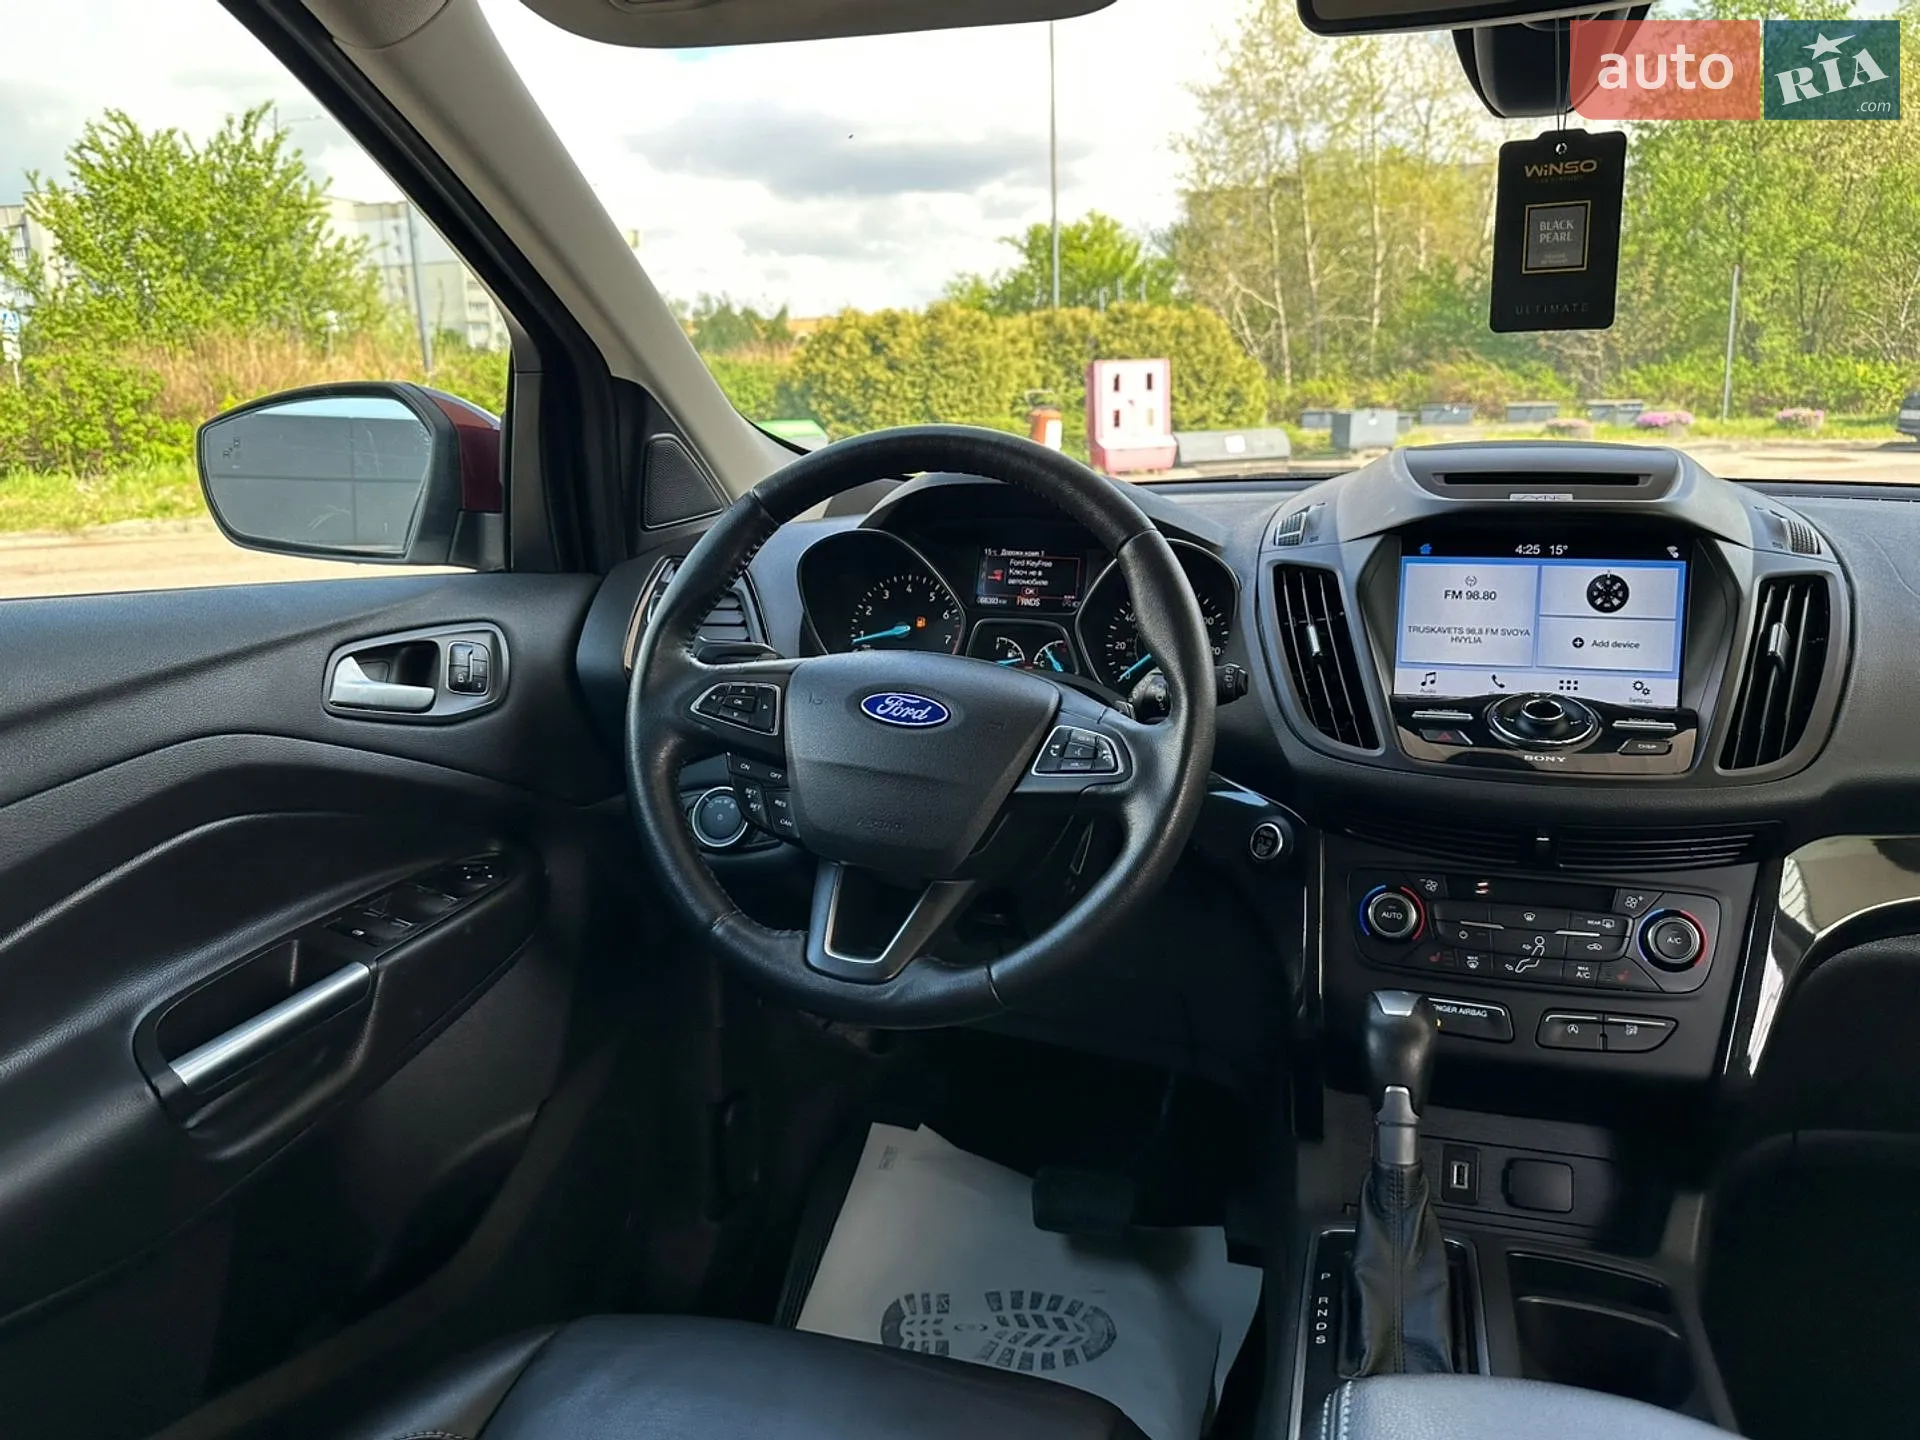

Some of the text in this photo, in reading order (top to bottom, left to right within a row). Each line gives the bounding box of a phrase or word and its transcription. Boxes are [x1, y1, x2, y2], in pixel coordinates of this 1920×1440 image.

[1539, 219, 1574, 231] BLACK
[1539, 231, 1573, 243] PEARL
[1515, 302, 1589, 315] ULTIMATE
[1515, 544, 1569, 555] 4:25 15°
[1009, 558, 1025, 567] Ford
[906, 584, 912, 593] 4
[883, 589, 890, 600] 3
[929, 591, 936, 602] 5
[1444, 589, 1498, 601] FM 98.80
[865, 605, 873, 616] 2
[942, 610, 950, 620] 6
[1408, 625, 1464, 635] TRUSKAVETS
[1485, 628, 1499, 636] FM
[1500, 628, 1531, 637] SVOYA
[944, 634, 952, 645] 7
[1450, 636, 1482, 644] HVYLIA
[1591, 639, 1640, 649] Add device
[1114, 641, 1127, 650] 20
[876, 696, 932, 720] Ford
[740, 763, 751, 771] ON
[769, 771, 782, 779] OFF
[1381, 911, 1403, 920] AUTO
[1666, 936, 1682, 944] A/C
[1575, 970, 1591, 979] A/C
[1458, 1006, 1488, 1018] AIRBAG
[1321, 1272, 1331, 1281] P
[1317, 1308, 1328, 1317] N
[1316, 1321, 1328, 1331] D
